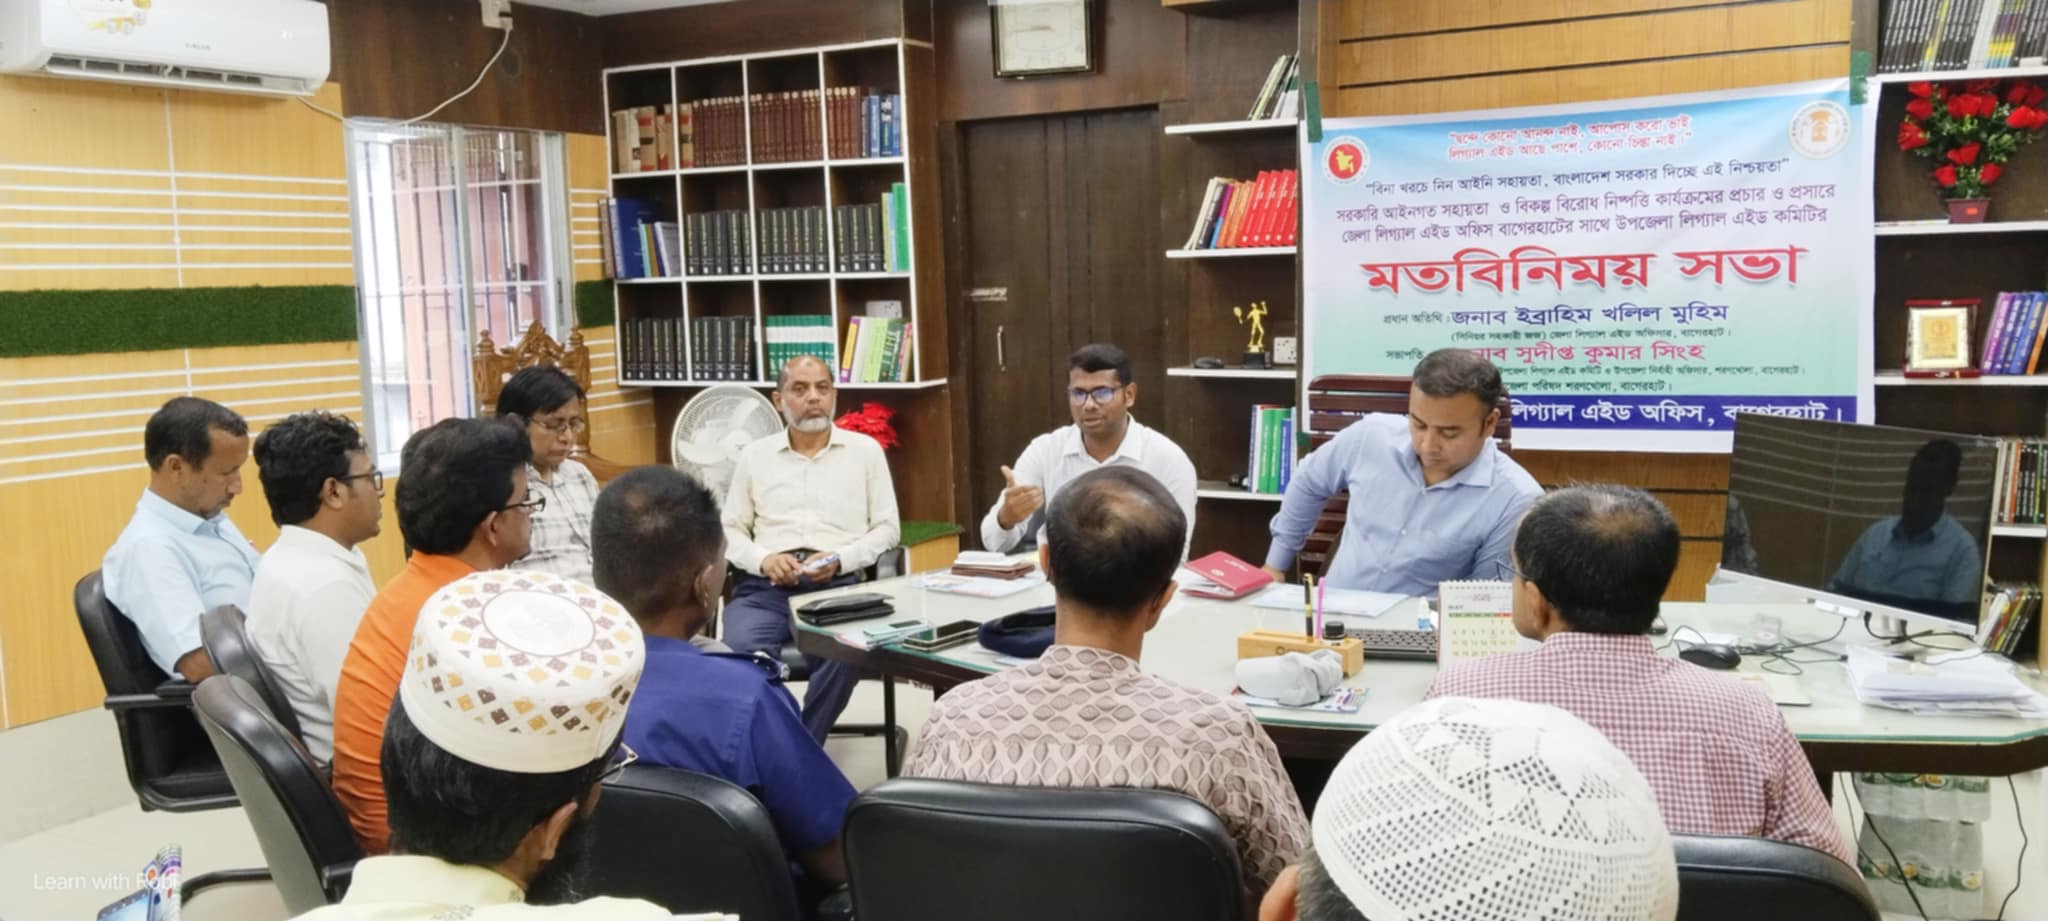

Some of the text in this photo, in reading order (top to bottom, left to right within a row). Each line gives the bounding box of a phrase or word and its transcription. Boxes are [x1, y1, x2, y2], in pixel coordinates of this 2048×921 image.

[1433, 178, 1453, 191] নিন
[1458, 175, 1493, 191] আইনি
[1553, 171, 1611, 185] বাংলাদেশ
[1615, 168, 1658, 181] সরকার
[1703, 162, 1724, 176] এই
[1337, 204, 1378, 222] সরকারি
[1383, 203, 1437, 221] আইনগত
[1442, 201, 1489, 217] সহায়তা
[1500, 201, 1510, 214] ও
[1516, 196, 1551, 214] বিকল্প
[1556, 193, 1599, 212] বিরোধ
[1655, 187, 1724, 206] কার্যক্রমের
[1729, 187, 1765, 202] প্রচার
[1772, 187, 1784, 200] ও
[1789, 183, 1836, 199] প্রসারে
[1342, 204, 1828, 243] জেলা লিগ্যাল এইড অফিস বাগেরহাটের সাথে উপজেলা লিগ্যাল এইড কমিটির
[1360, 245, 1809, 294] মতবিনিময় সভা
[1450, 310, 1508, 325] জনাব
[1515, 304, 1592, 326] ইব্রাহিম
[1602, 302, 1662, 322] খলিল
[1670, 301, 1729, 324] মুহিম
[1515, 341, 1575, 363] সুদীপ্ত
[1583, 345, 1643, 364] কুমার
[1652, 340, 1706, 360] সিংহ
[1510, 398, 1575, 422] লিগ্যাল
[1581, 399, 1634, 422] এইড
